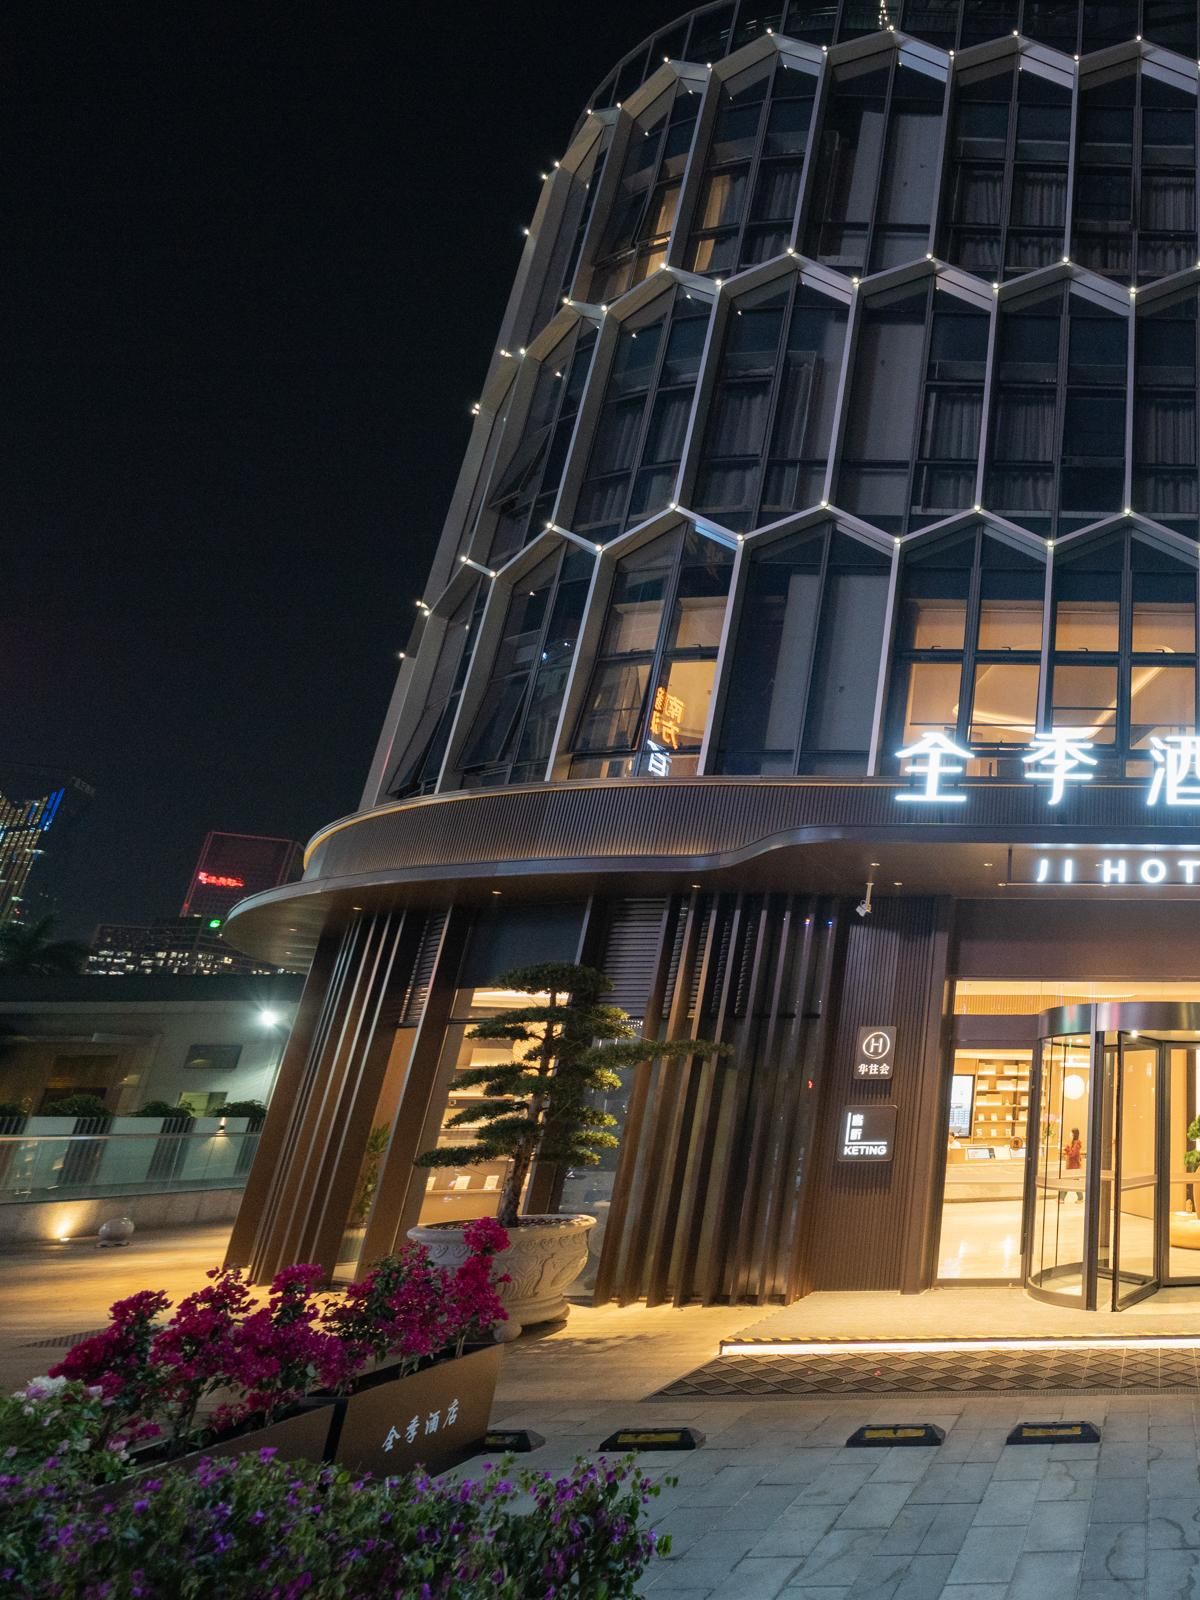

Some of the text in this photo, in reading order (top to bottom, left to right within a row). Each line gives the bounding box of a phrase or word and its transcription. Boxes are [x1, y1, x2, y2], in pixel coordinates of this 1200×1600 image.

[1036, 859, 1073, 883] JI
[857, 1063, 890, 1075] 华住会
[843, 1145, 888, 1156] KETING
[381, 1398, 459, 1452] 全季酒店
